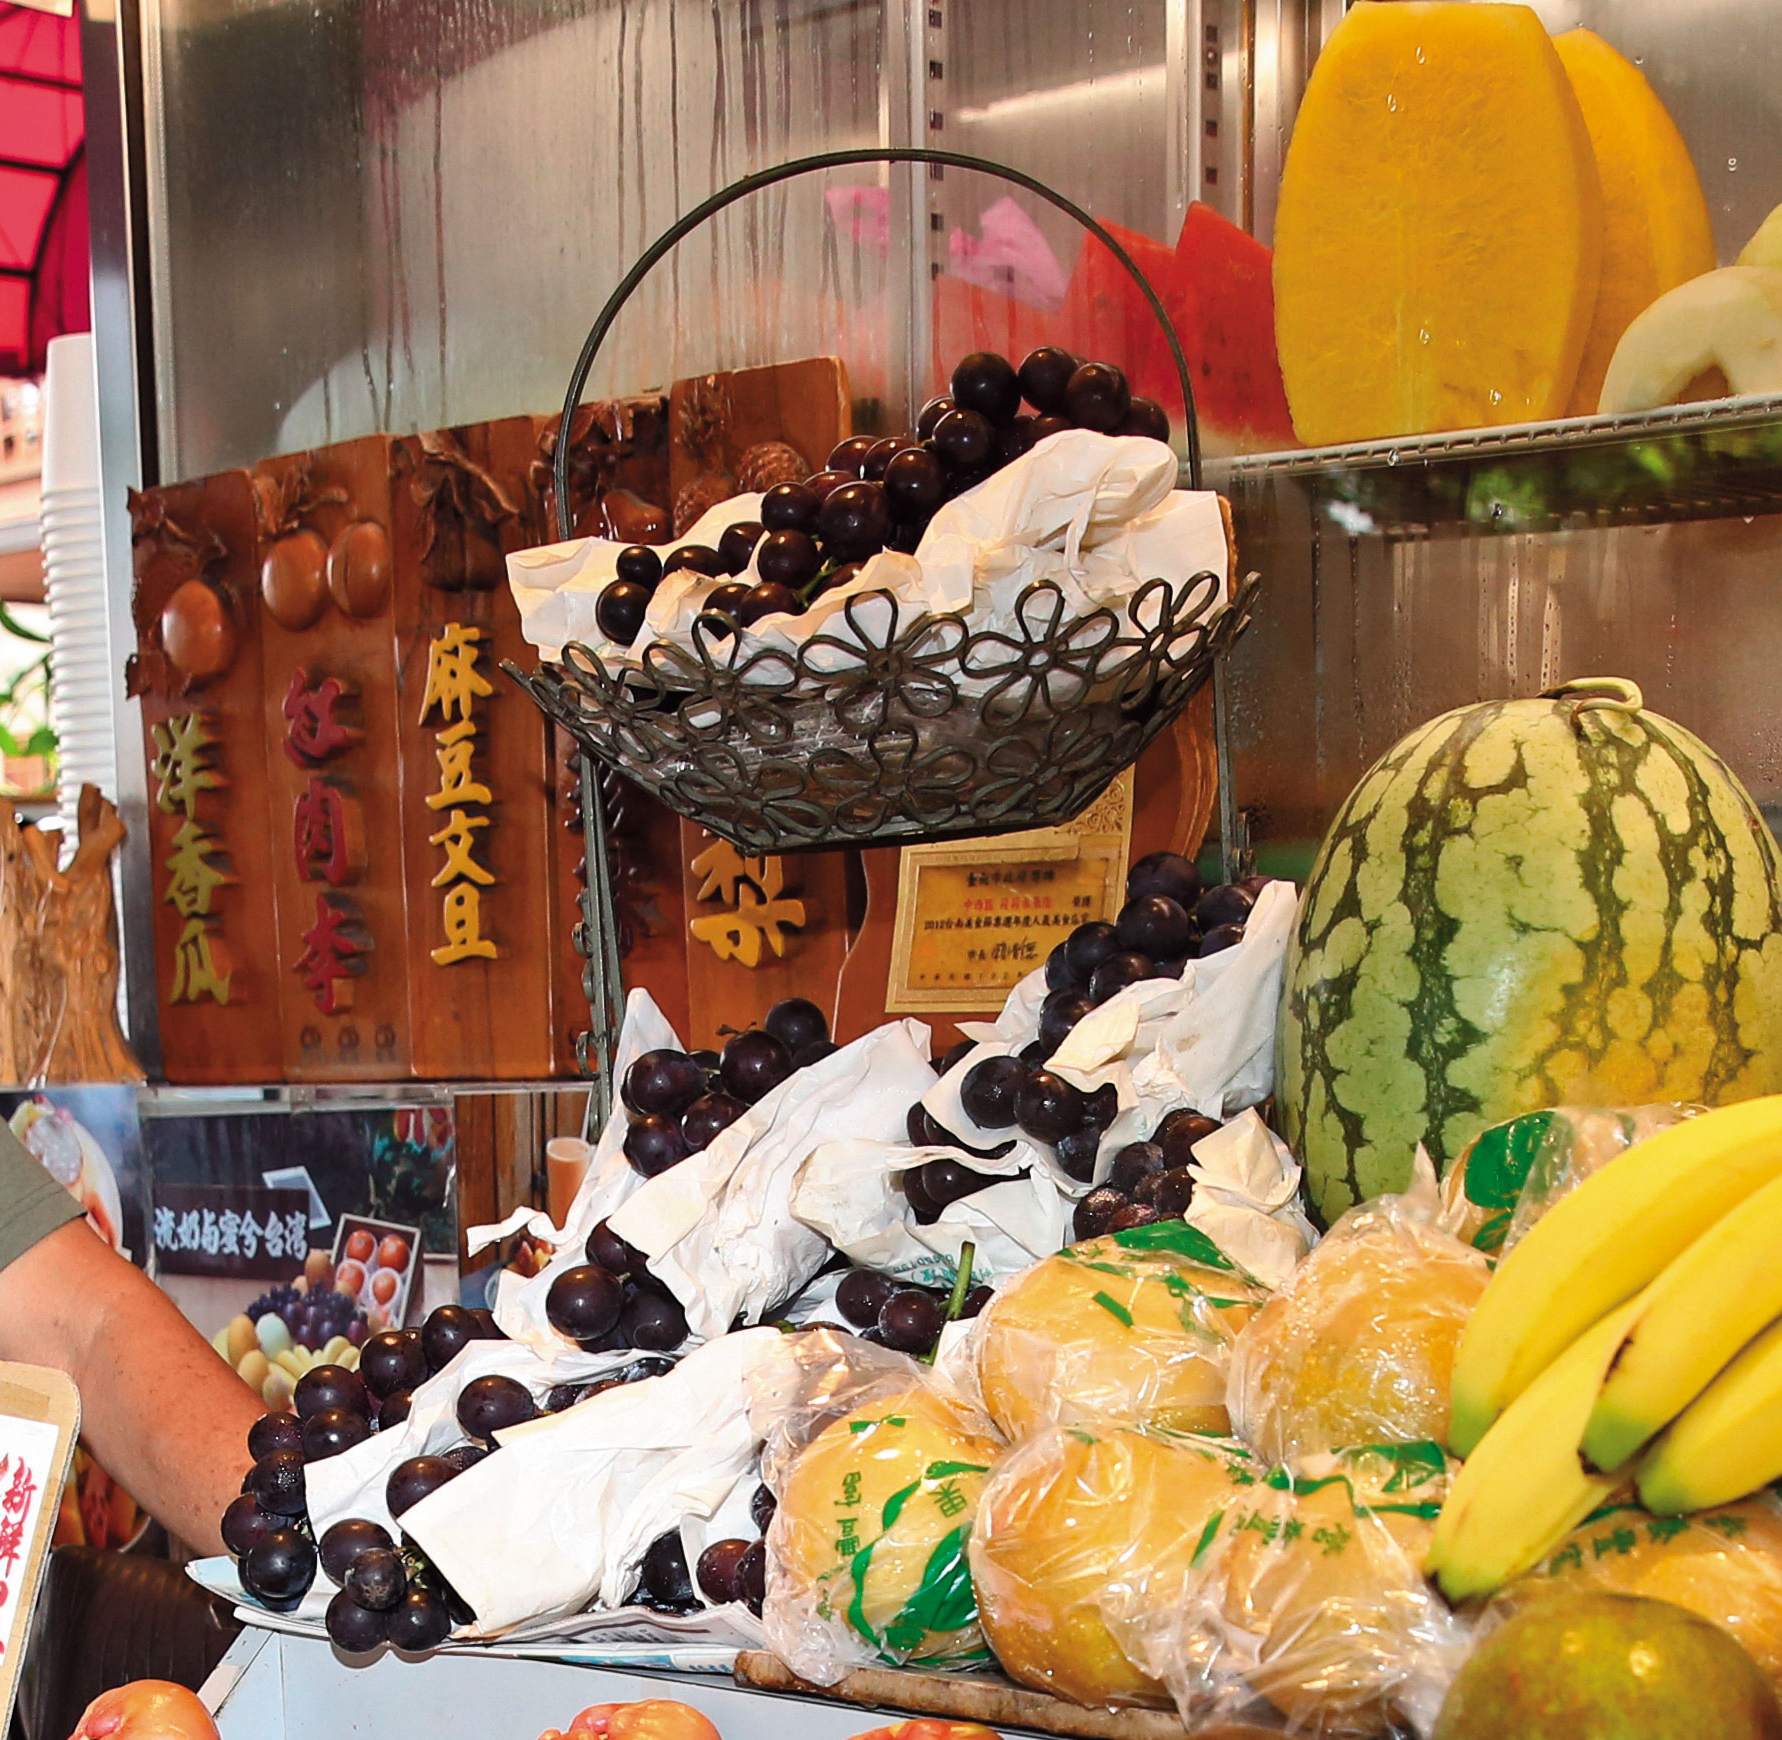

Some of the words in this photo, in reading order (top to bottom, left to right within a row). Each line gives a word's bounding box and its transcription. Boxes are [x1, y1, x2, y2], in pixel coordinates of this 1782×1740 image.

[150, 712, 231, 1006] 洋香瓜
[419, 622, 498, 967] 麻豆文旦
[927, 1478, 968, 1519] 果
